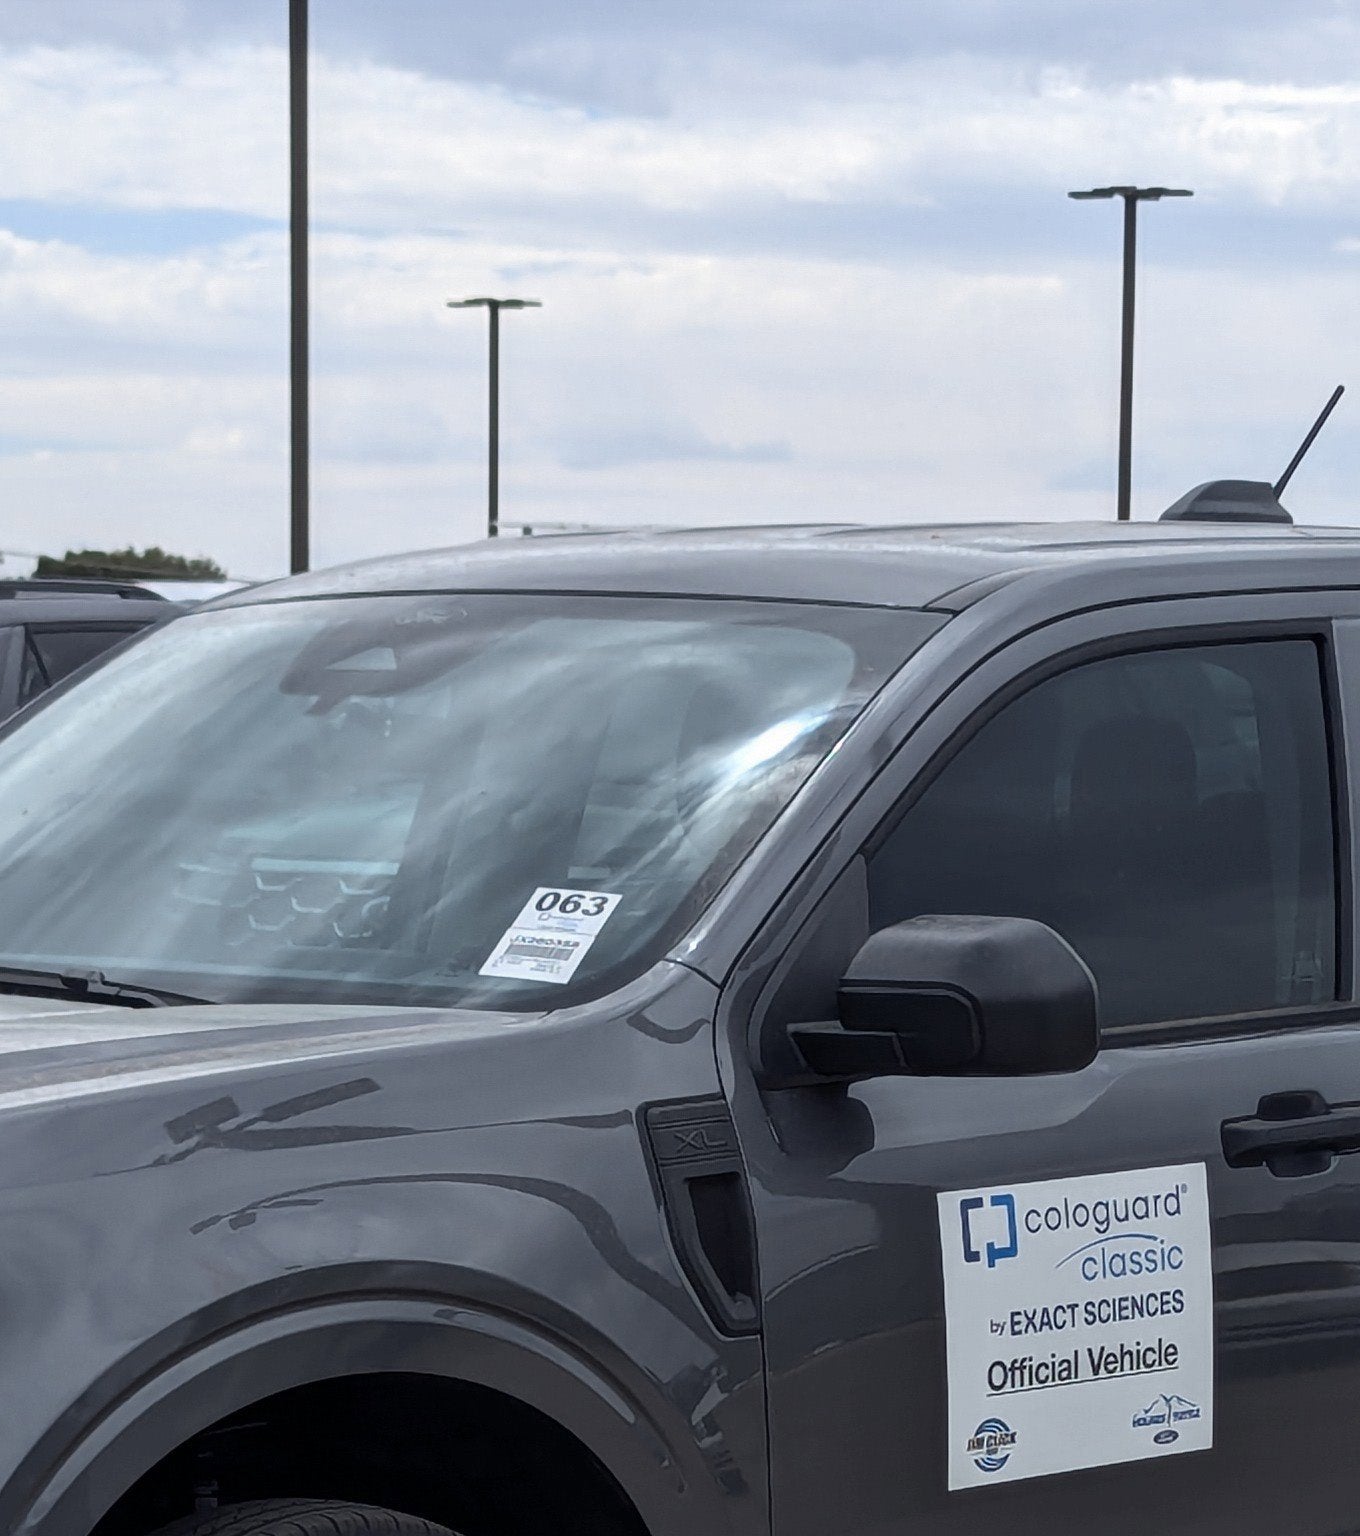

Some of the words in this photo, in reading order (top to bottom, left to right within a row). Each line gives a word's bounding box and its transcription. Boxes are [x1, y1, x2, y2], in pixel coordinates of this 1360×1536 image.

[535, 892, 609, 916] 063
[673, 1129, 728, 1152] XL
[1081, 1239, 1184, 1281] classic
[990, 1319, 1007, 1336] by
[1010, 1303, 1079, 1336] EXACT
[1084, 1289, 1185, 1326] SCIENCES
[987, 1349, 1079, 1391] Official
[1086, 1337, 1180, 1376] Vehicle
